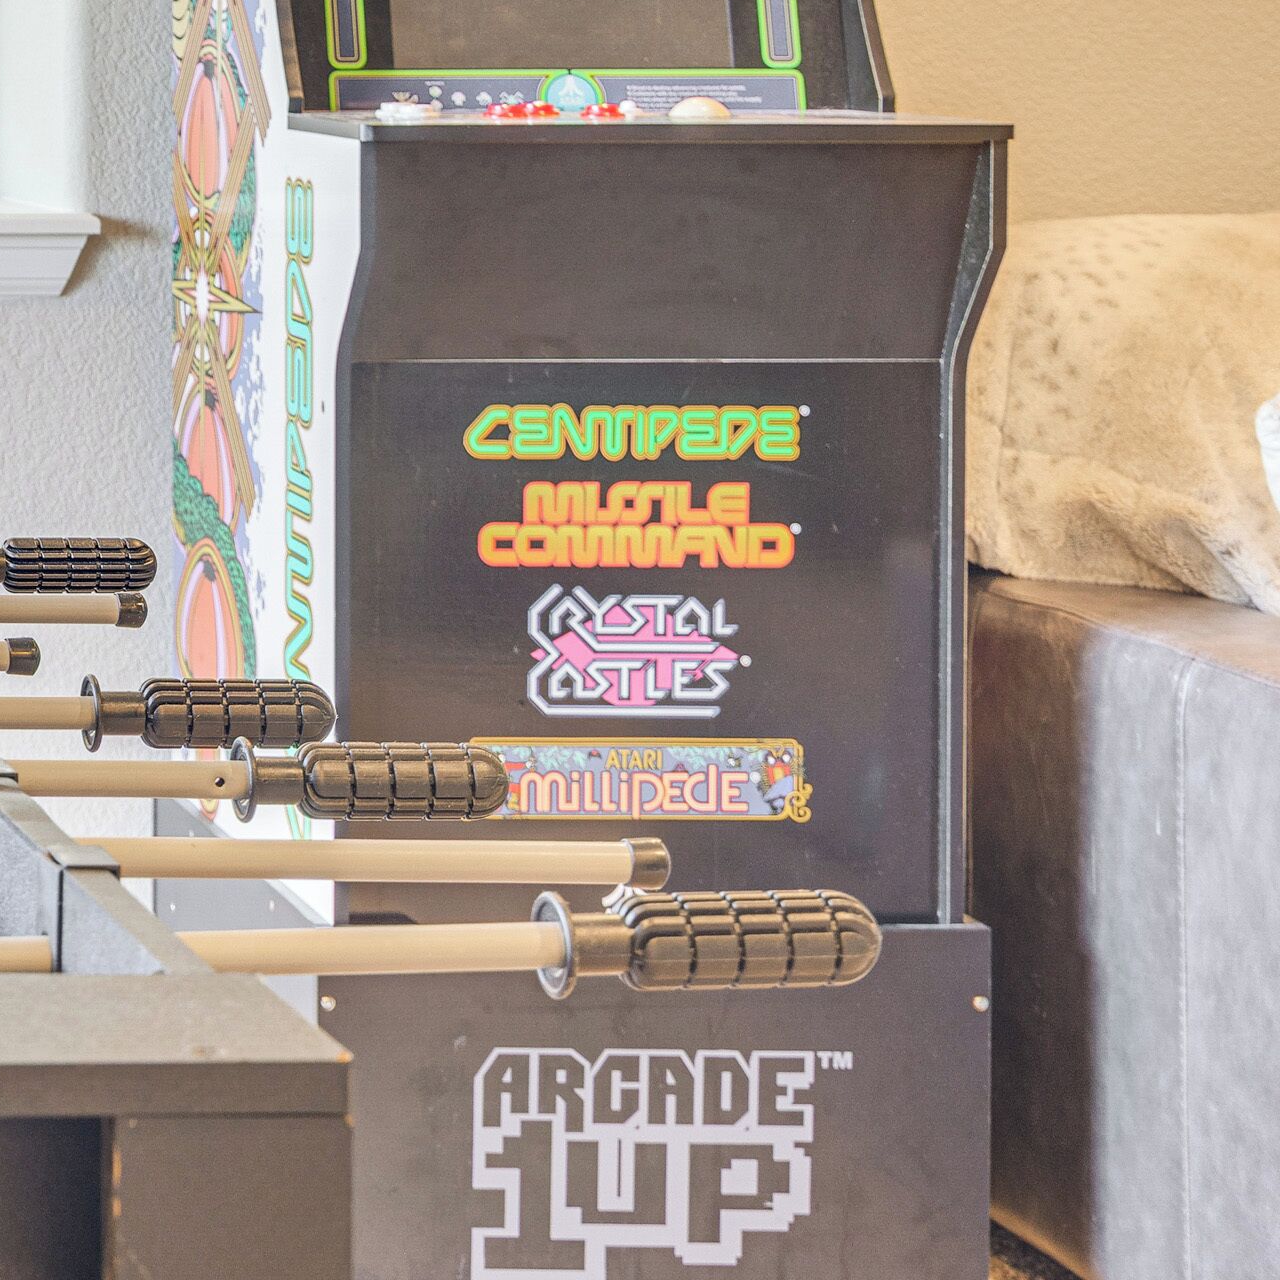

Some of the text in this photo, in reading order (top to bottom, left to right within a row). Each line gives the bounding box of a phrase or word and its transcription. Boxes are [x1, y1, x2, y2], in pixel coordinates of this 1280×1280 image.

[463, 404, 801, 461] CENTIPEDE
[523, 481, 750, 524] MISSILE
[478, 521, 795, 568] COMMAND
[527, 584, 739, 653] CRYSTAL
[527, 657, 733, 718] CASTLES
[605, 749, 662, 771] ATARI
[473, 1047, 814, 1136] ARCADE
[472, 1120, 812, 1280] 1UP
